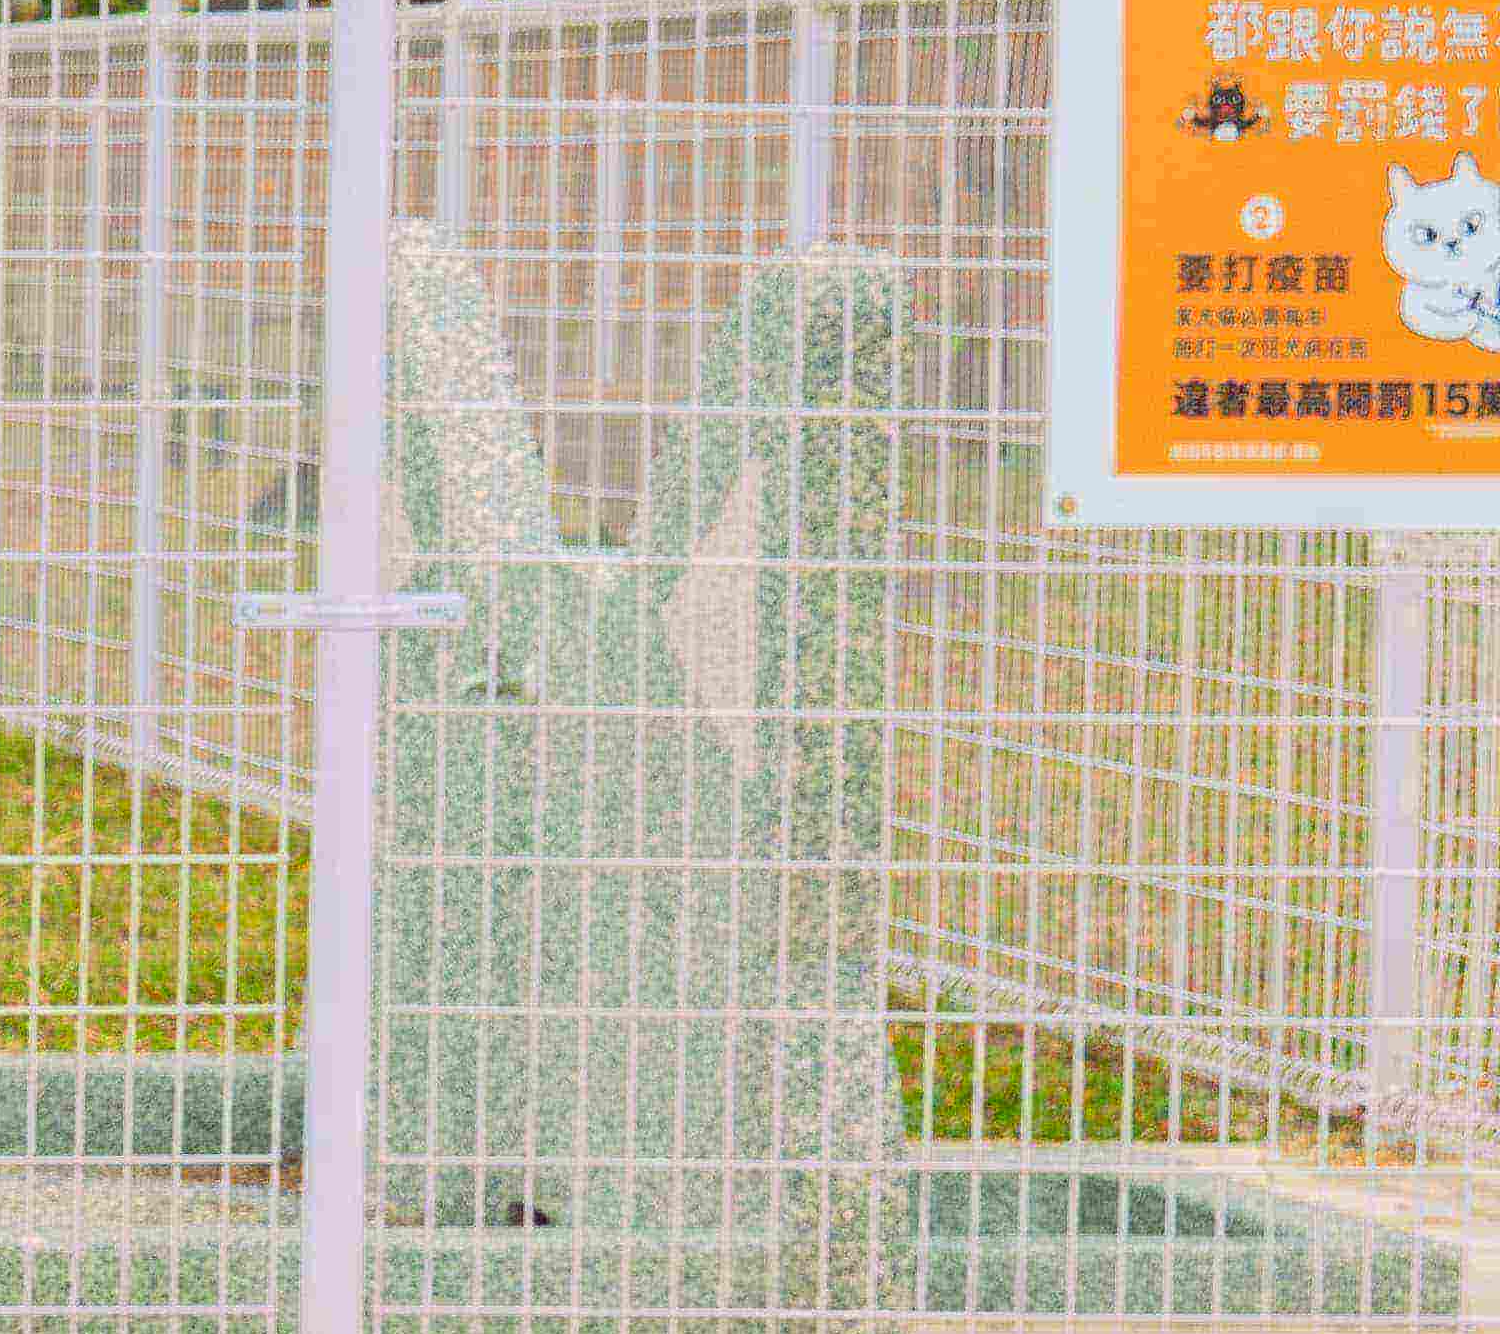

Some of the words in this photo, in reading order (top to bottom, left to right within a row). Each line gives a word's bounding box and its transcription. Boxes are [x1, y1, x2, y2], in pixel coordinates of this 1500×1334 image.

[1284, 78, 1500, 142] 要罰錢了
[1175, 252, 1350, 293] 要打疫苗
